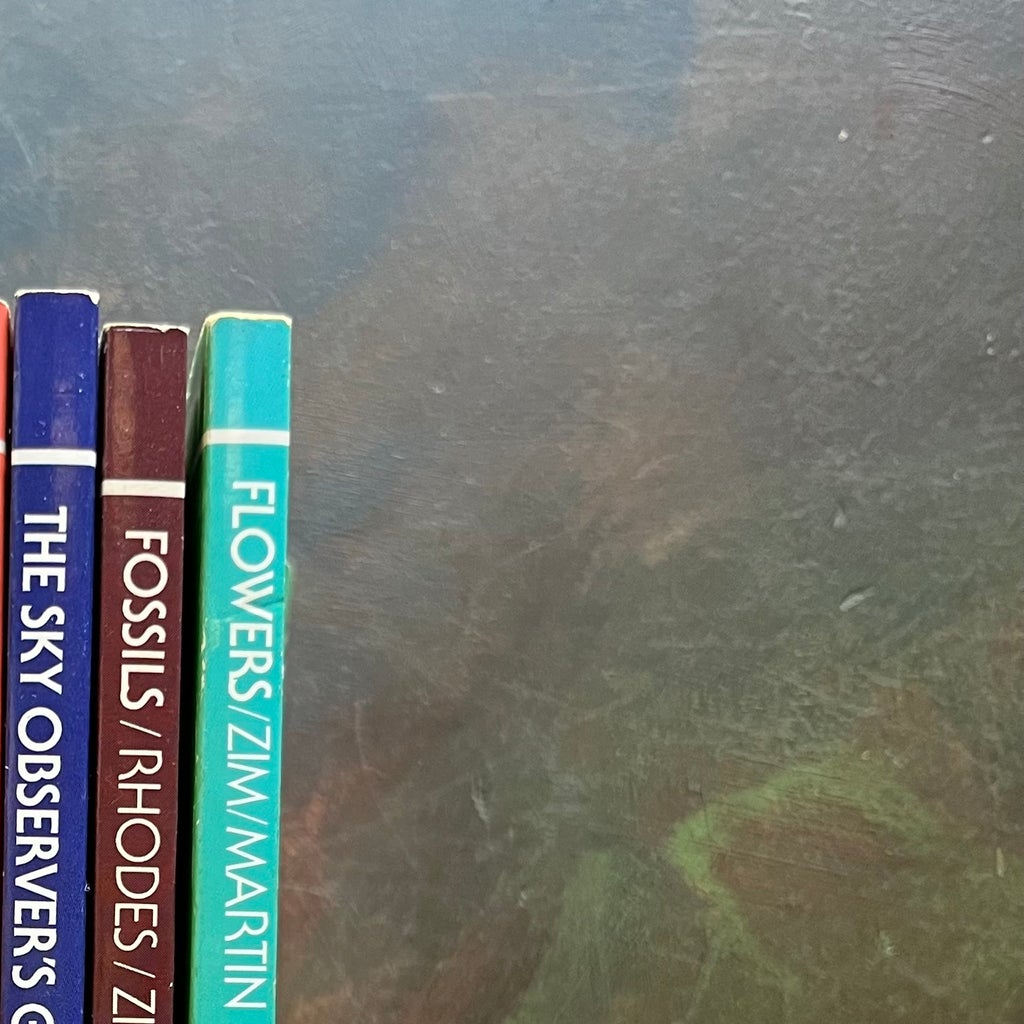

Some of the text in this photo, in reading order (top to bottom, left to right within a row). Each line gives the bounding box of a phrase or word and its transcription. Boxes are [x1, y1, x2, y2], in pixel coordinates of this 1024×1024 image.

[22, 504, 69, 592] THE
[119, 529, 169, 711] FOSSILS
[19, 604, 65, 696] SKY
[12, 706, 63, 989] OBSERVER'S
[114, 748, 164, 952] RHODES
